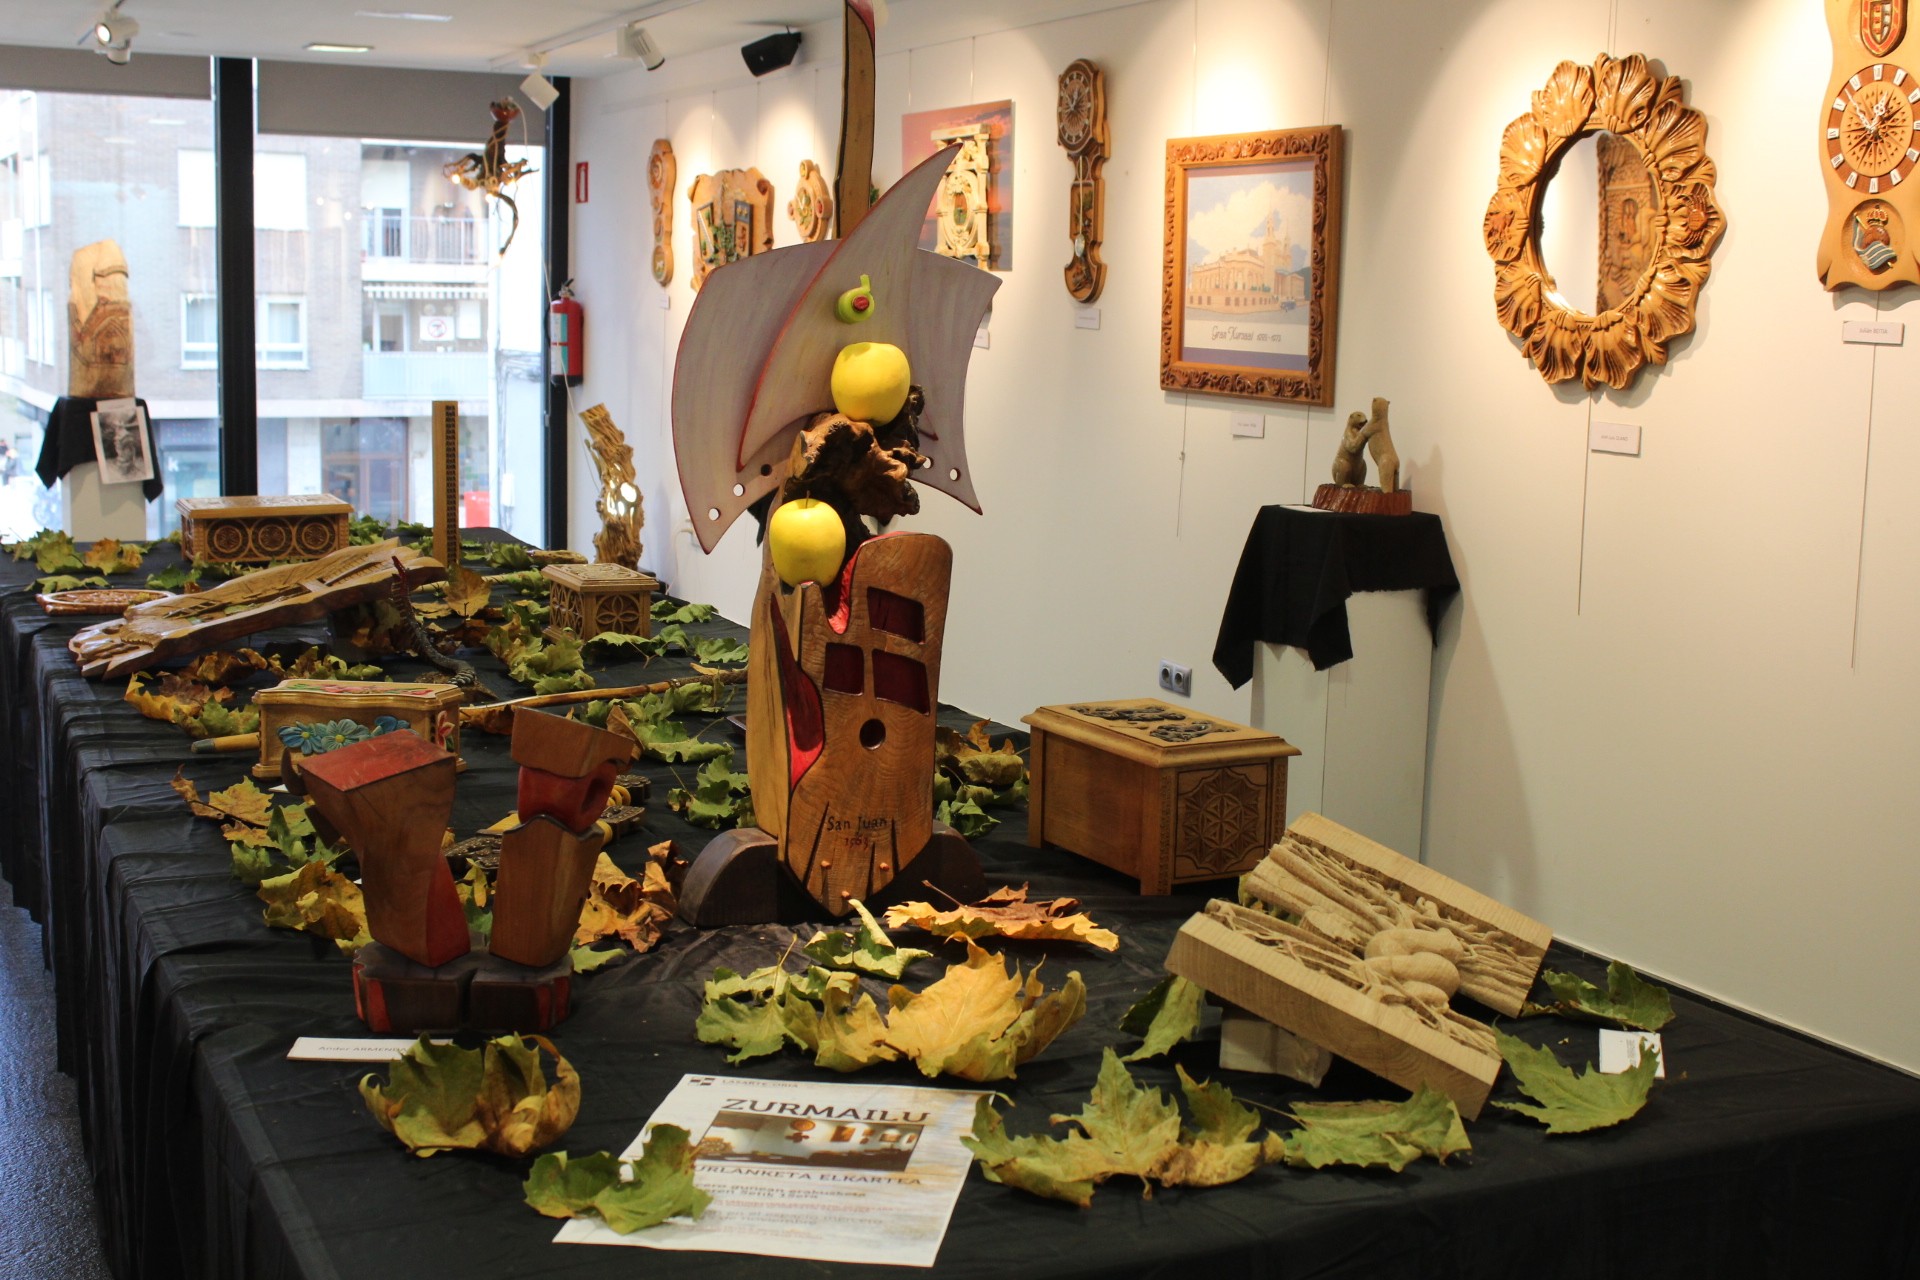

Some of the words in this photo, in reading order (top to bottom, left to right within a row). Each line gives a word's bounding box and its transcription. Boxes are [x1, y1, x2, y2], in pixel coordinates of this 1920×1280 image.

[827, 816, 851, 832] San
[855, 816, 887, 837] Juan
[721, 1098, 931, 1123] ZURMAILU
[694, 1165, 811, 1181] URLANKETA
[819, 1173, 923, 1186] ELKARTEA
